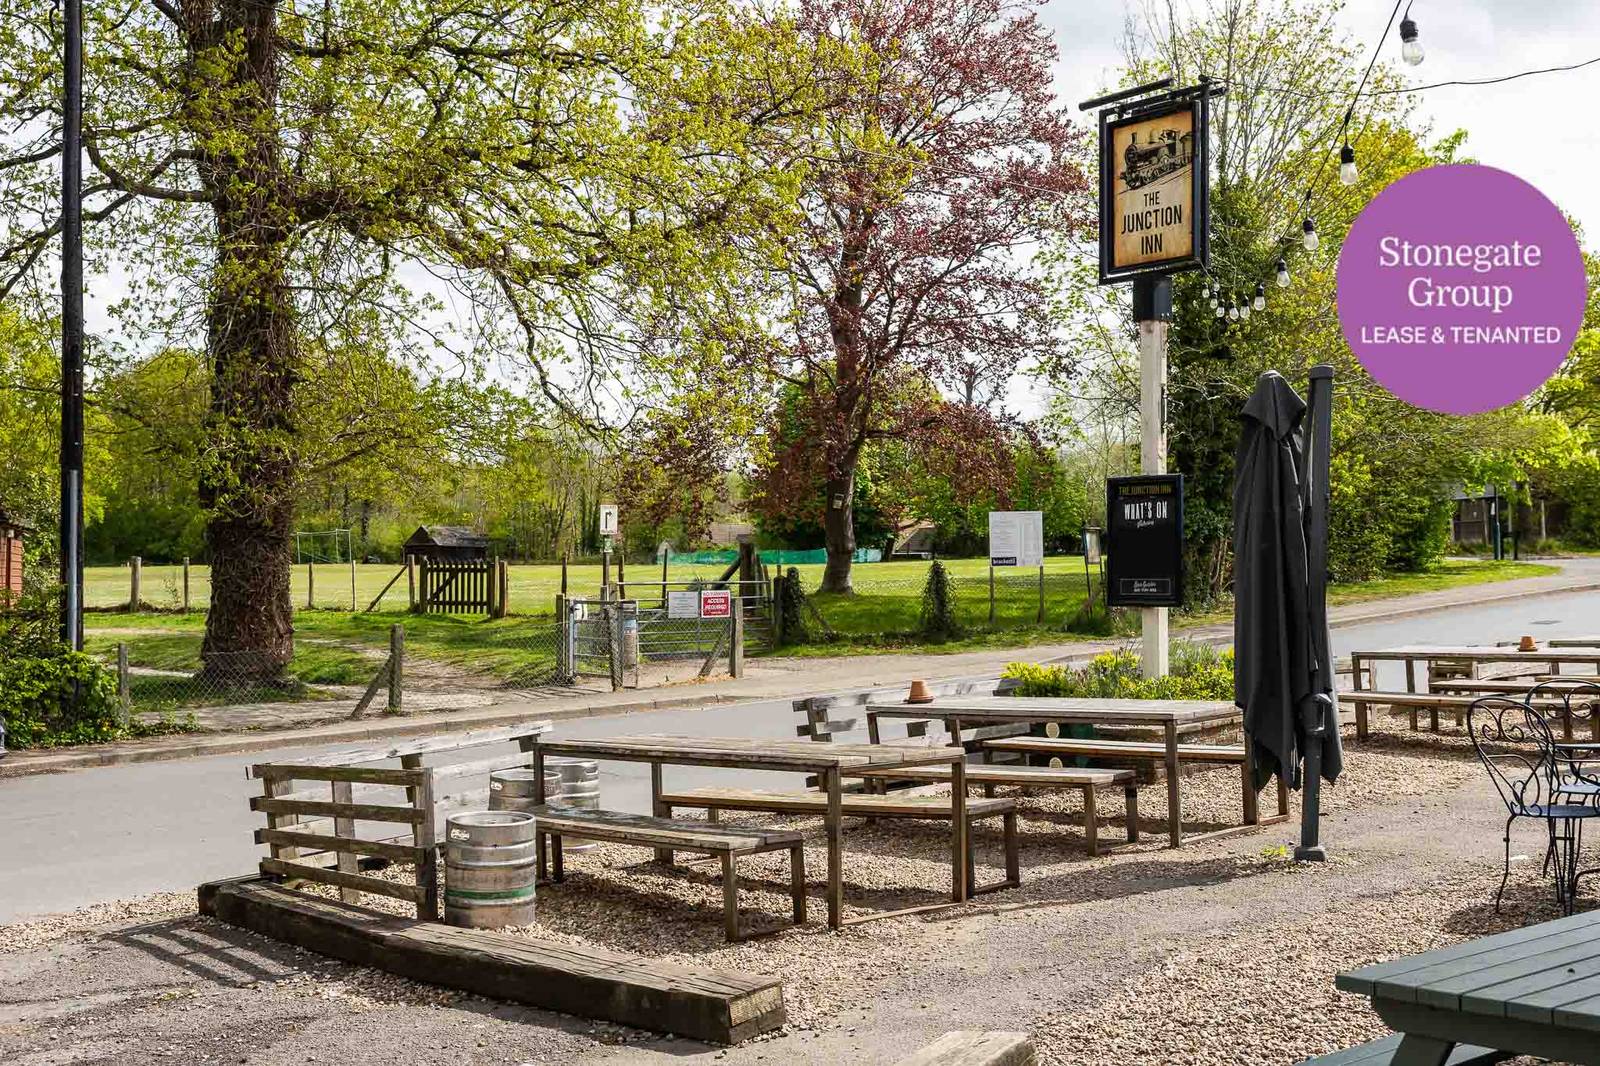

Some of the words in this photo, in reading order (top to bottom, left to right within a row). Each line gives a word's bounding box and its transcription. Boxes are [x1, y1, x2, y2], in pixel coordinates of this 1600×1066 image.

[1143, 190, 1160, 208] THE
[1121, 204, 1182, 234] JUNCTION
[1140, 232, 1163, 255] INN
[1124, 502, 1153, 520] WHAT'S
[1156, 500, 1168, 519] ON
